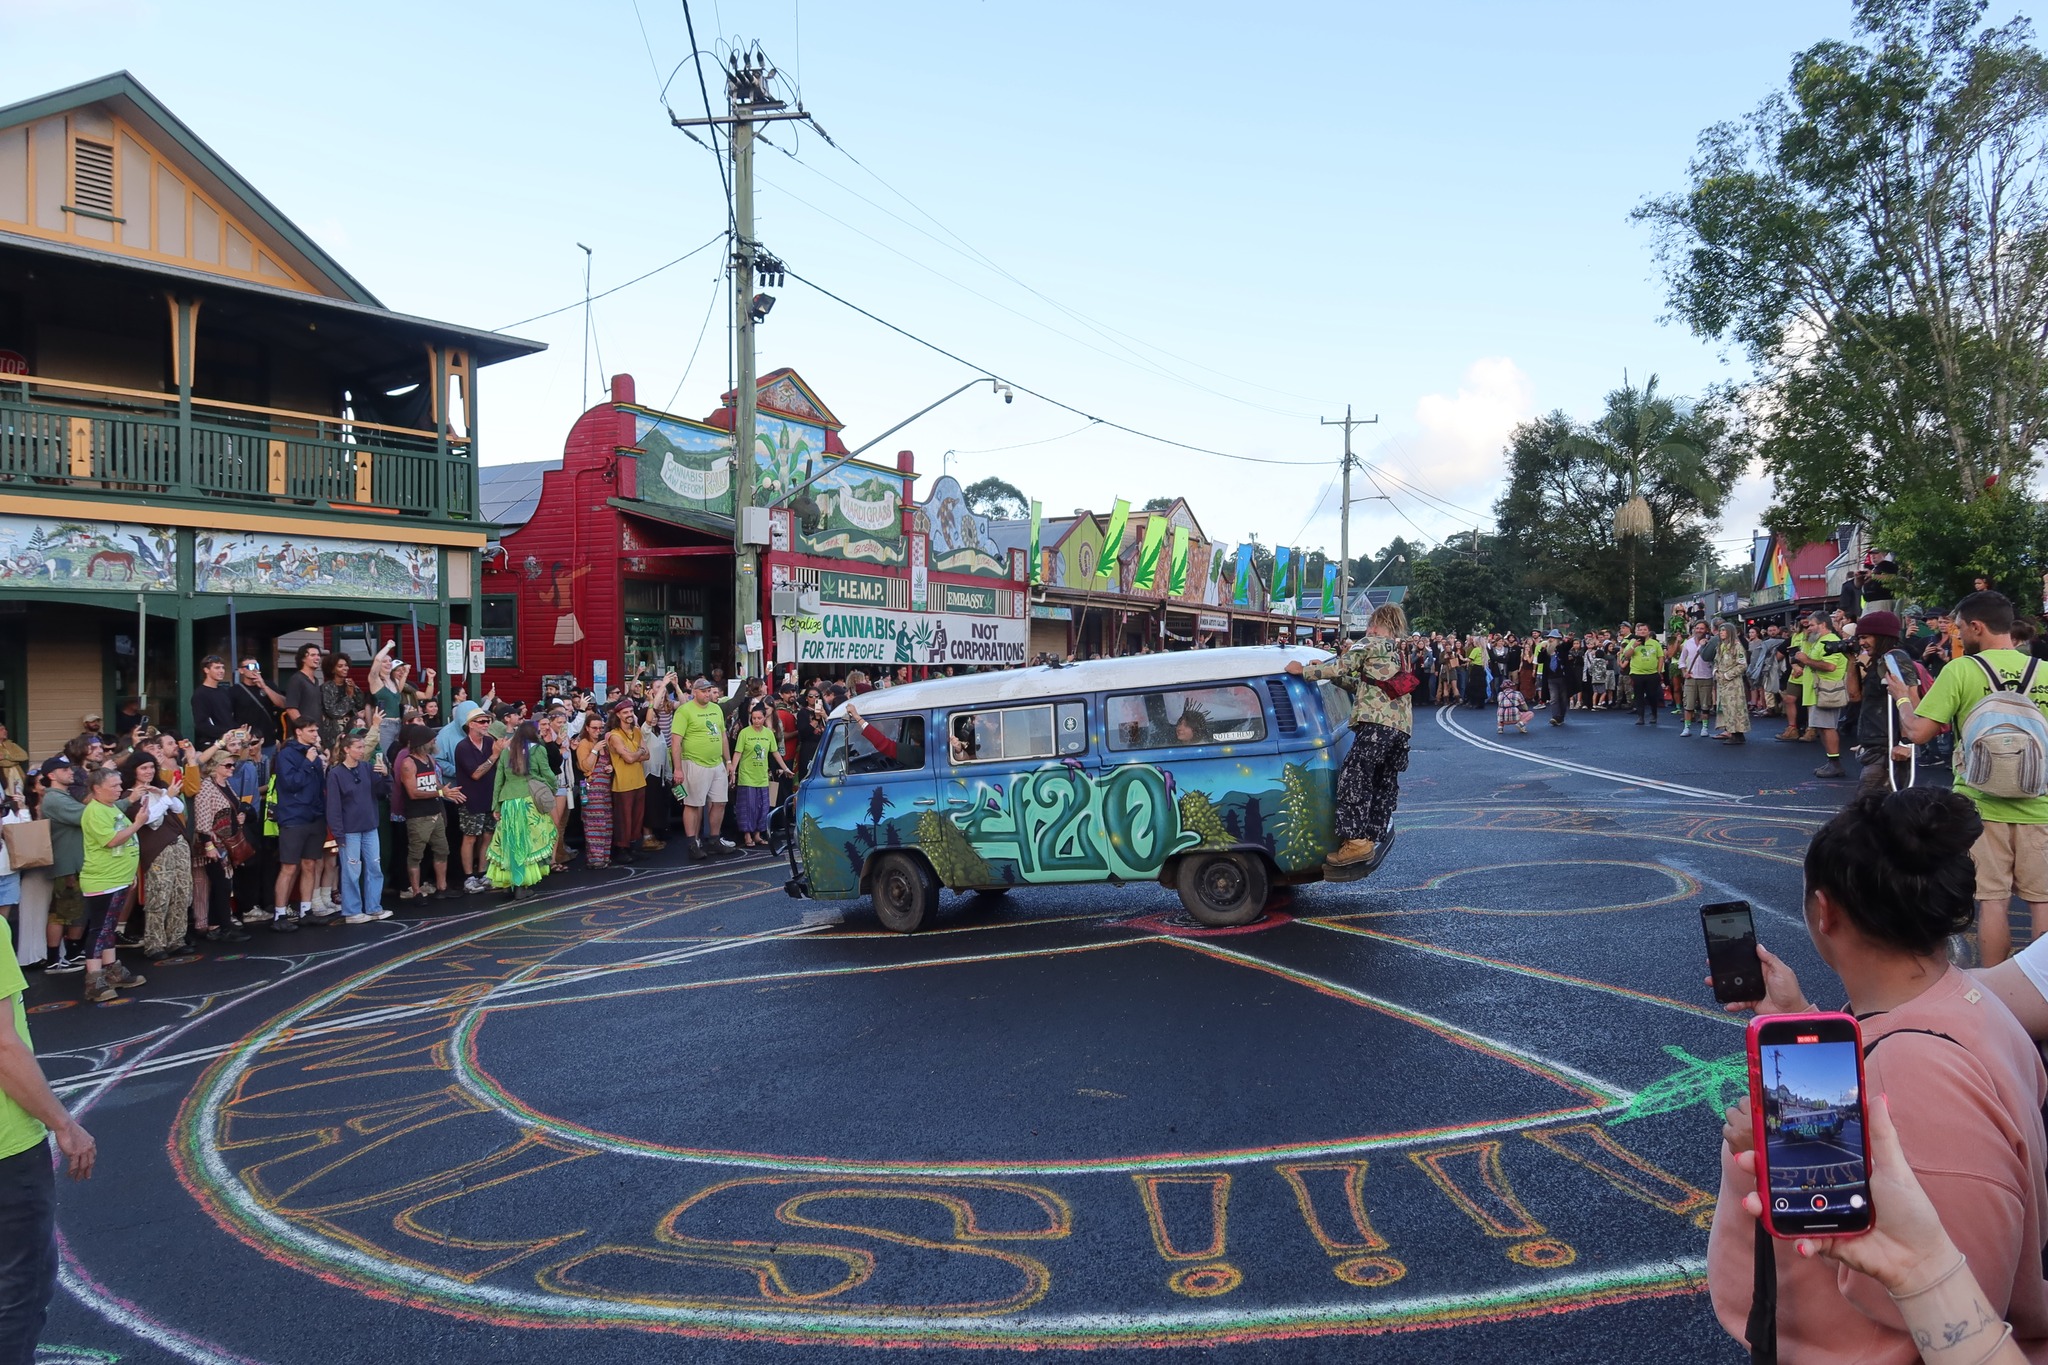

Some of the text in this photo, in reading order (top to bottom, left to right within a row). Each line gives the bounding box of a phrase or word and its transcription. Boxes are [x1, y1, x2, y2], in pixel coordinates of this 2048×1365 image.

[0, 357, 26, 375] TOP
[667, 461, 703, 482] CANNABIS
[664, 470, 704, 495] LAW REFORM
[843, 497, 866, 521] MARDI
[866, 503, 892, 523] GRASS
[853, 542, 881, 555] GLOBALLY
[838, 579, 884, 601] H.E.M.P.
[946, 591, 985, 609] EMBASSY
[823, 614, 896, 640] CANNABIS
[971, 622, 998, 640] NOT
[448, 641, 461, 651] 2P
[801, 640, 885, 661] FOR THE PEOPLE
[950, 639, 1025, 662] CORPORATIONS
[950, 764, 1201, 881] 420
